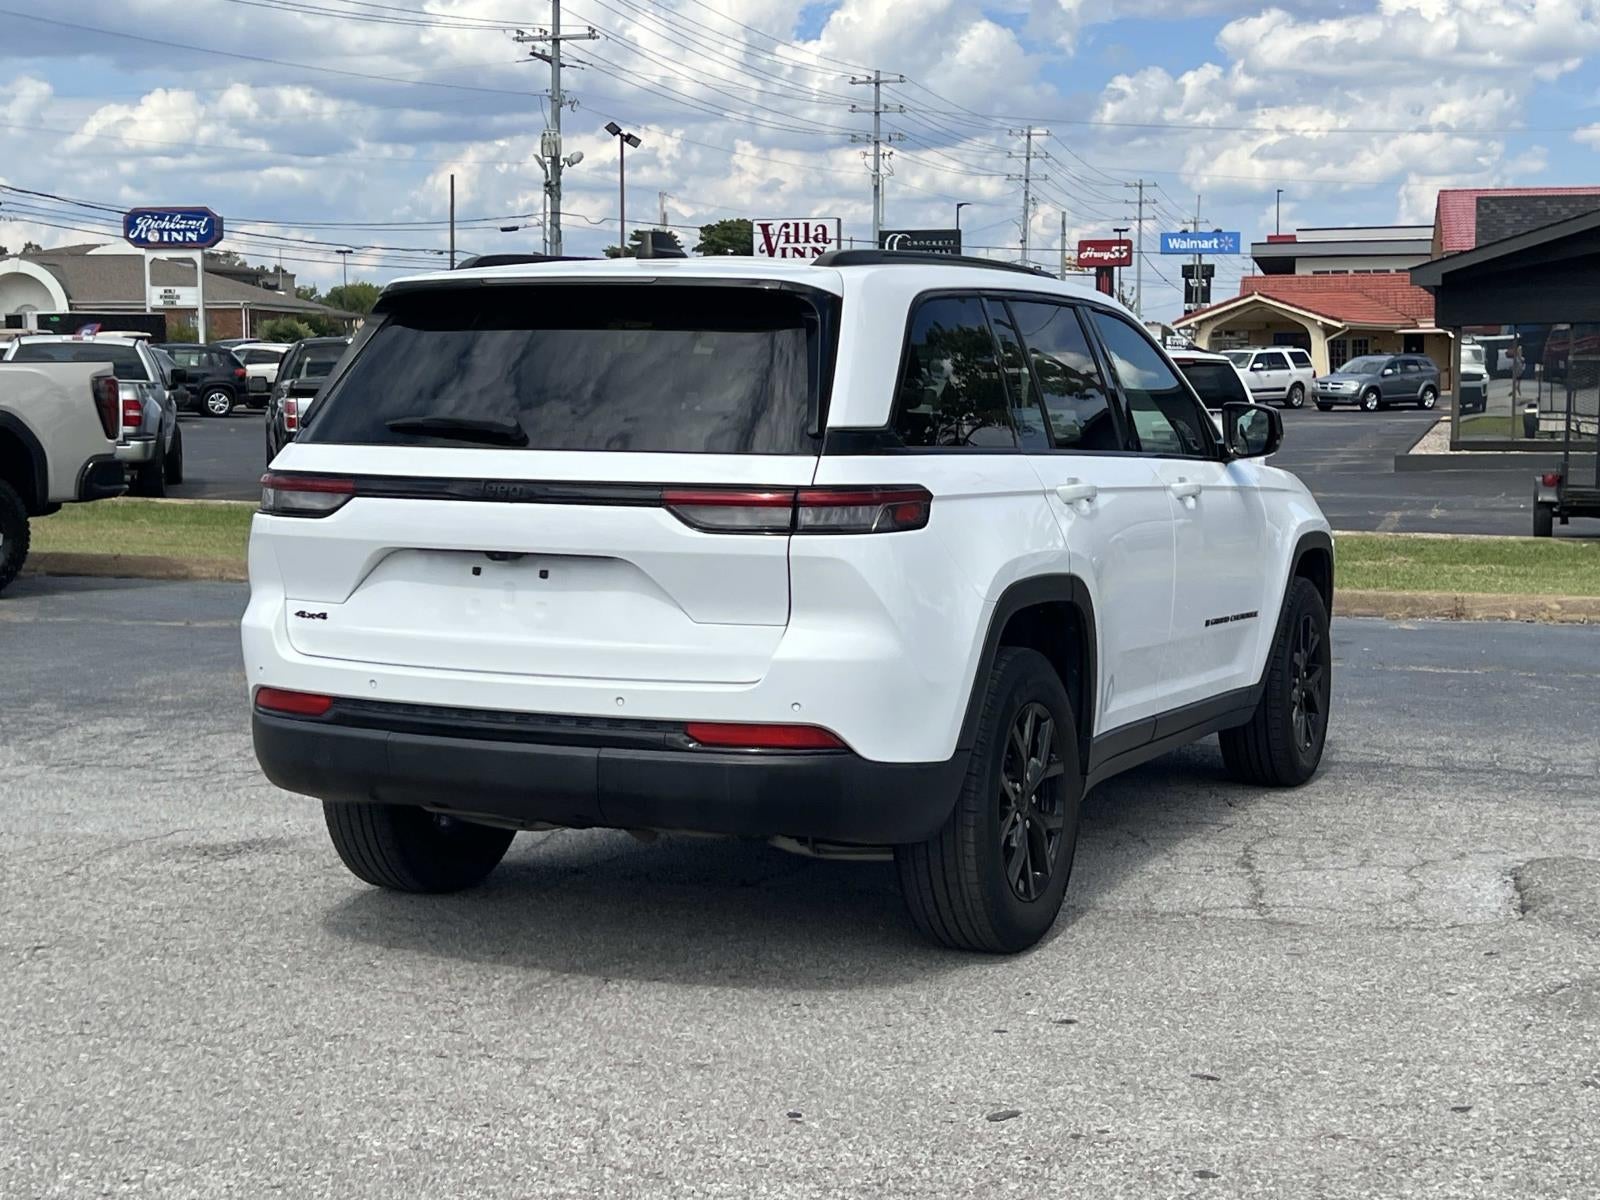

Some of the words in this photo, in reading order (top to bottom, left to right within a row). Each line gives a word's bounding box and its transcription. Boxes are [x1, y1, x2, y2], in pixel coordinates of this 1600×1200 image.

[129, 214, 208, 238] Richland
[163, 231, 198, 241] INN
[757, 222, 831, 257] Villa
[1168, 237, 1218, 249] Walmart
[780, 247, 826, 258] INN
[294, 610, 328, 620] 4x4
